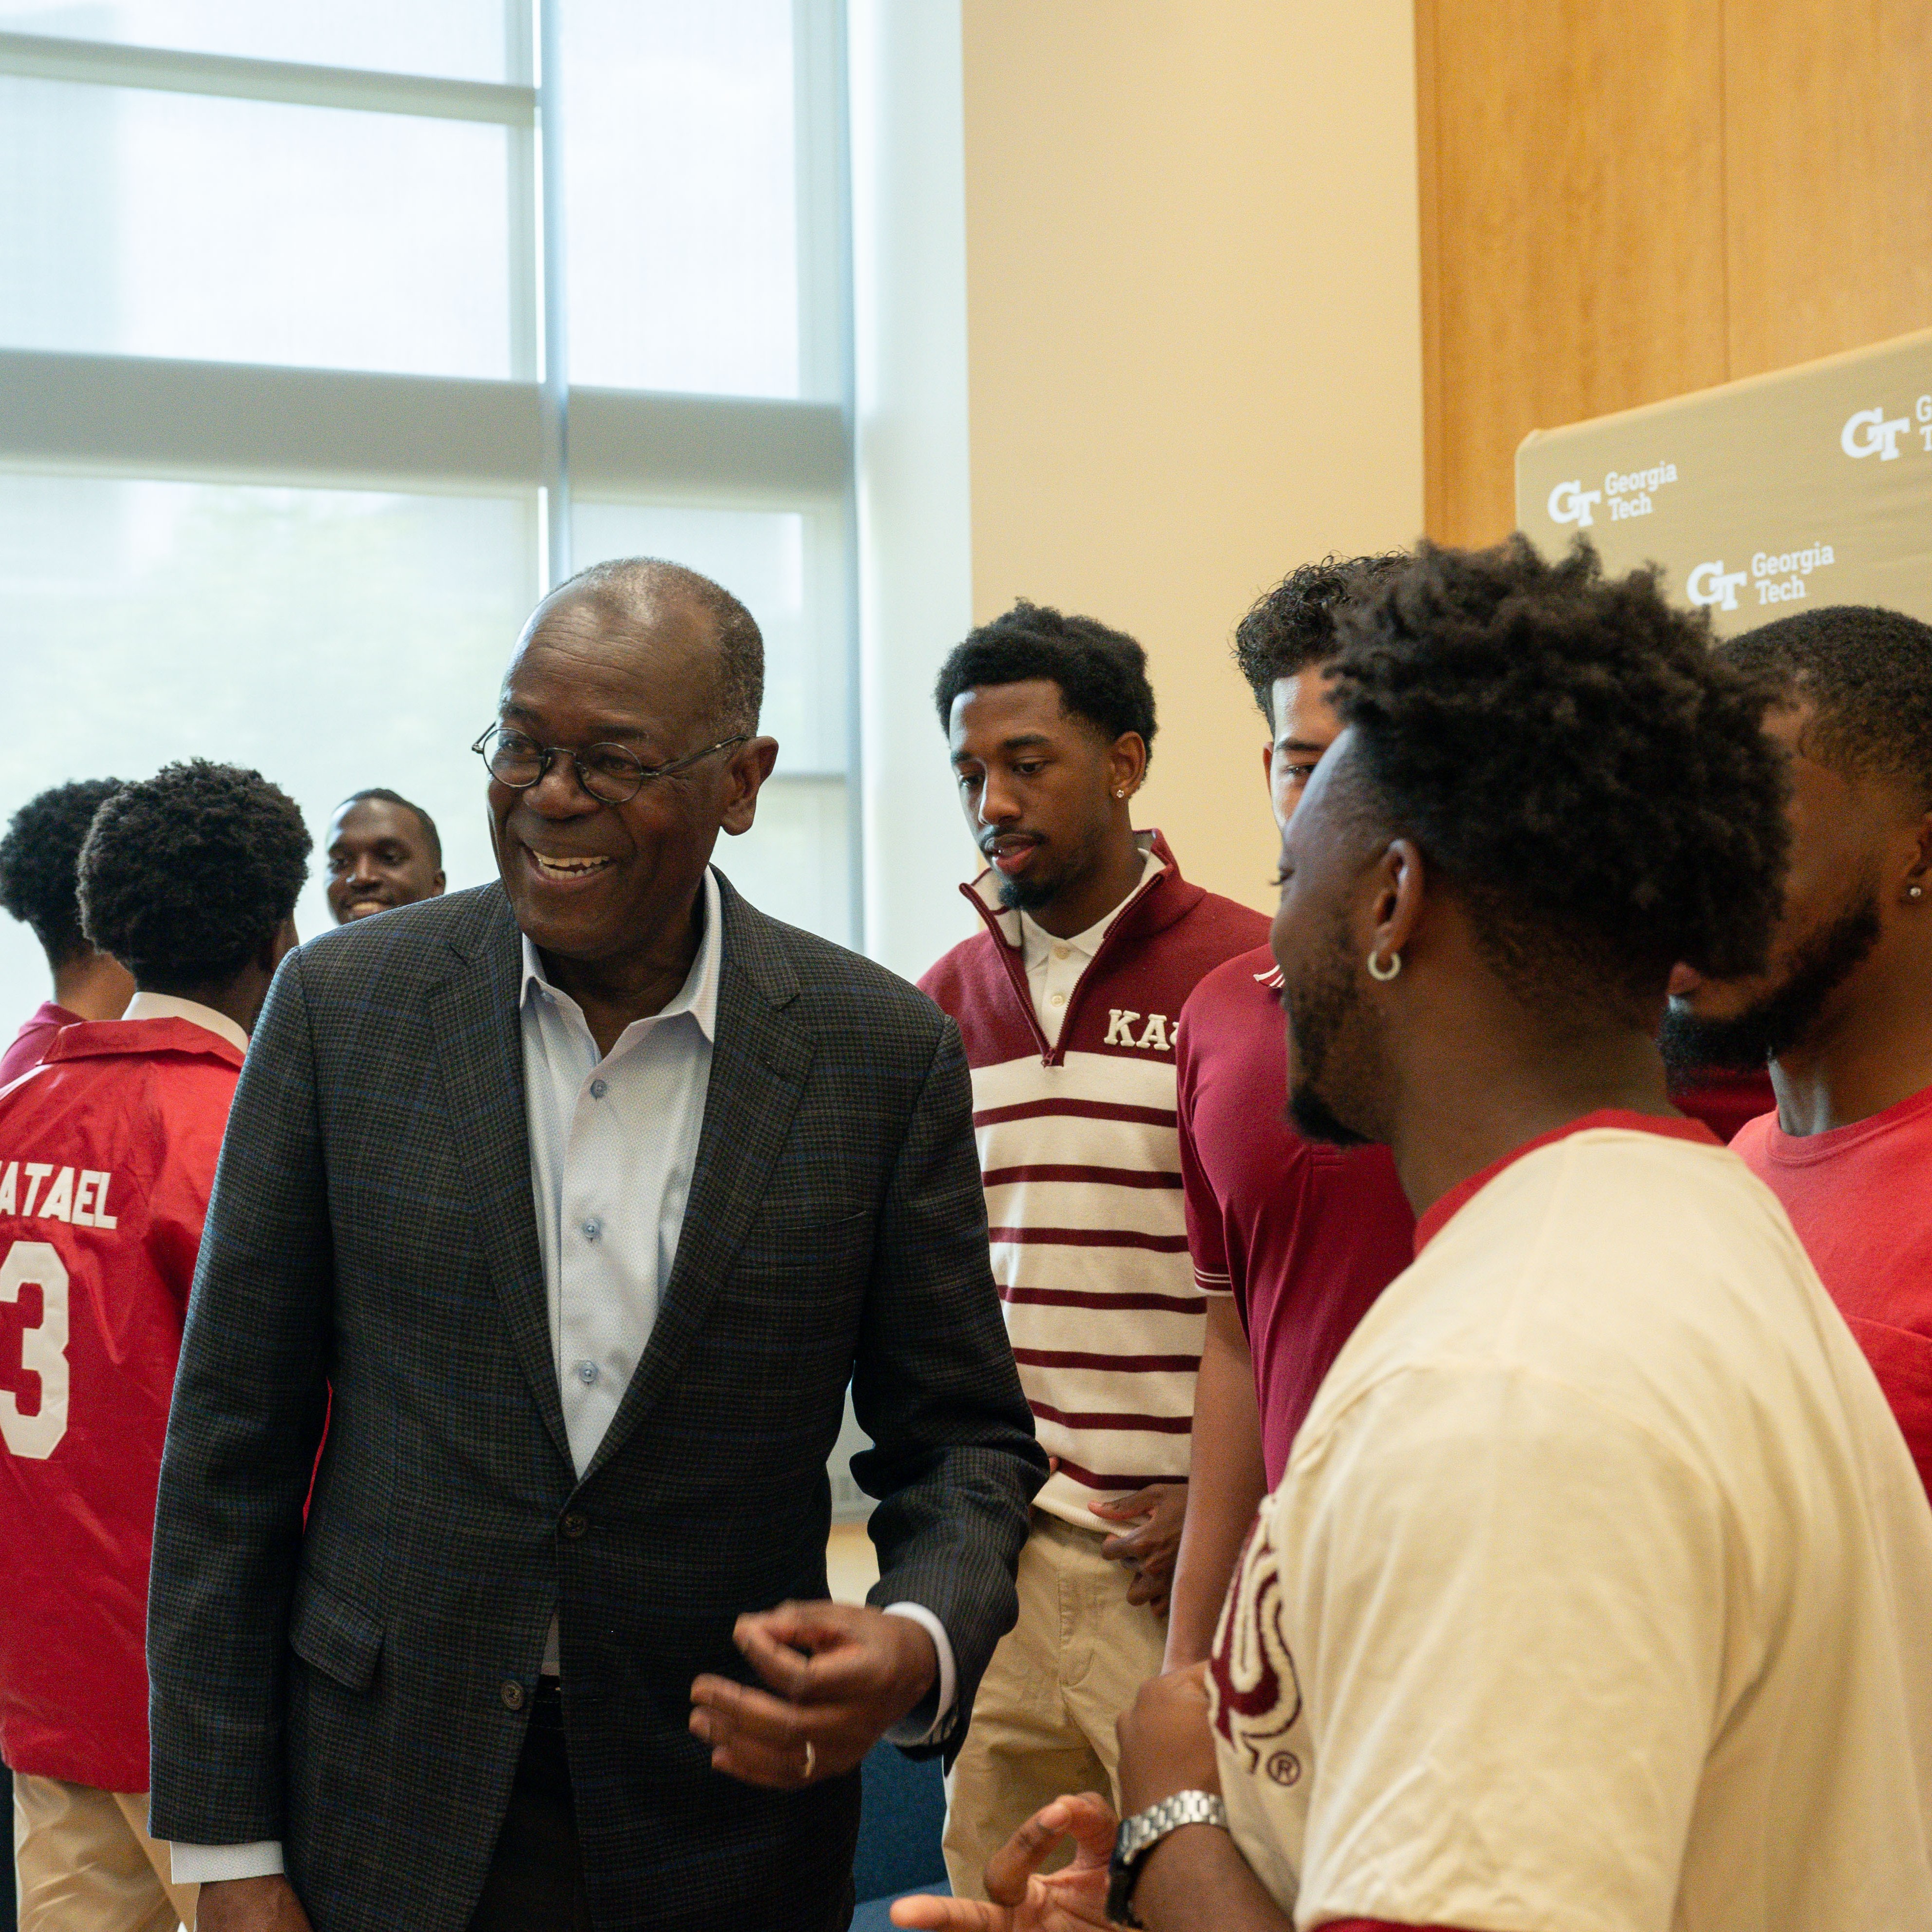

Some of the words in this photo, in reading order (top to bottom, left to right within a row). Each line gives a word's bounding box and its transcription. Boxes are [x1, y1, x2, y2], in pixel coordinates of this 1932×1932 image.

[1841, 406, 1910, 461] GT
[1605, 460, 1678, 496] Georgia
[1548, 479, 1601, 527] GT
[1608, 491, 1653, 521] Tech
[1752, 541, 1835, 577] Georgia
[1687, 560, 1747, 611] GT
[1755, 574, 1806, 605] Tech
[1104, 1009, 1179, 1052] KA
[0, 1160, 117, 1229] ATAEL
